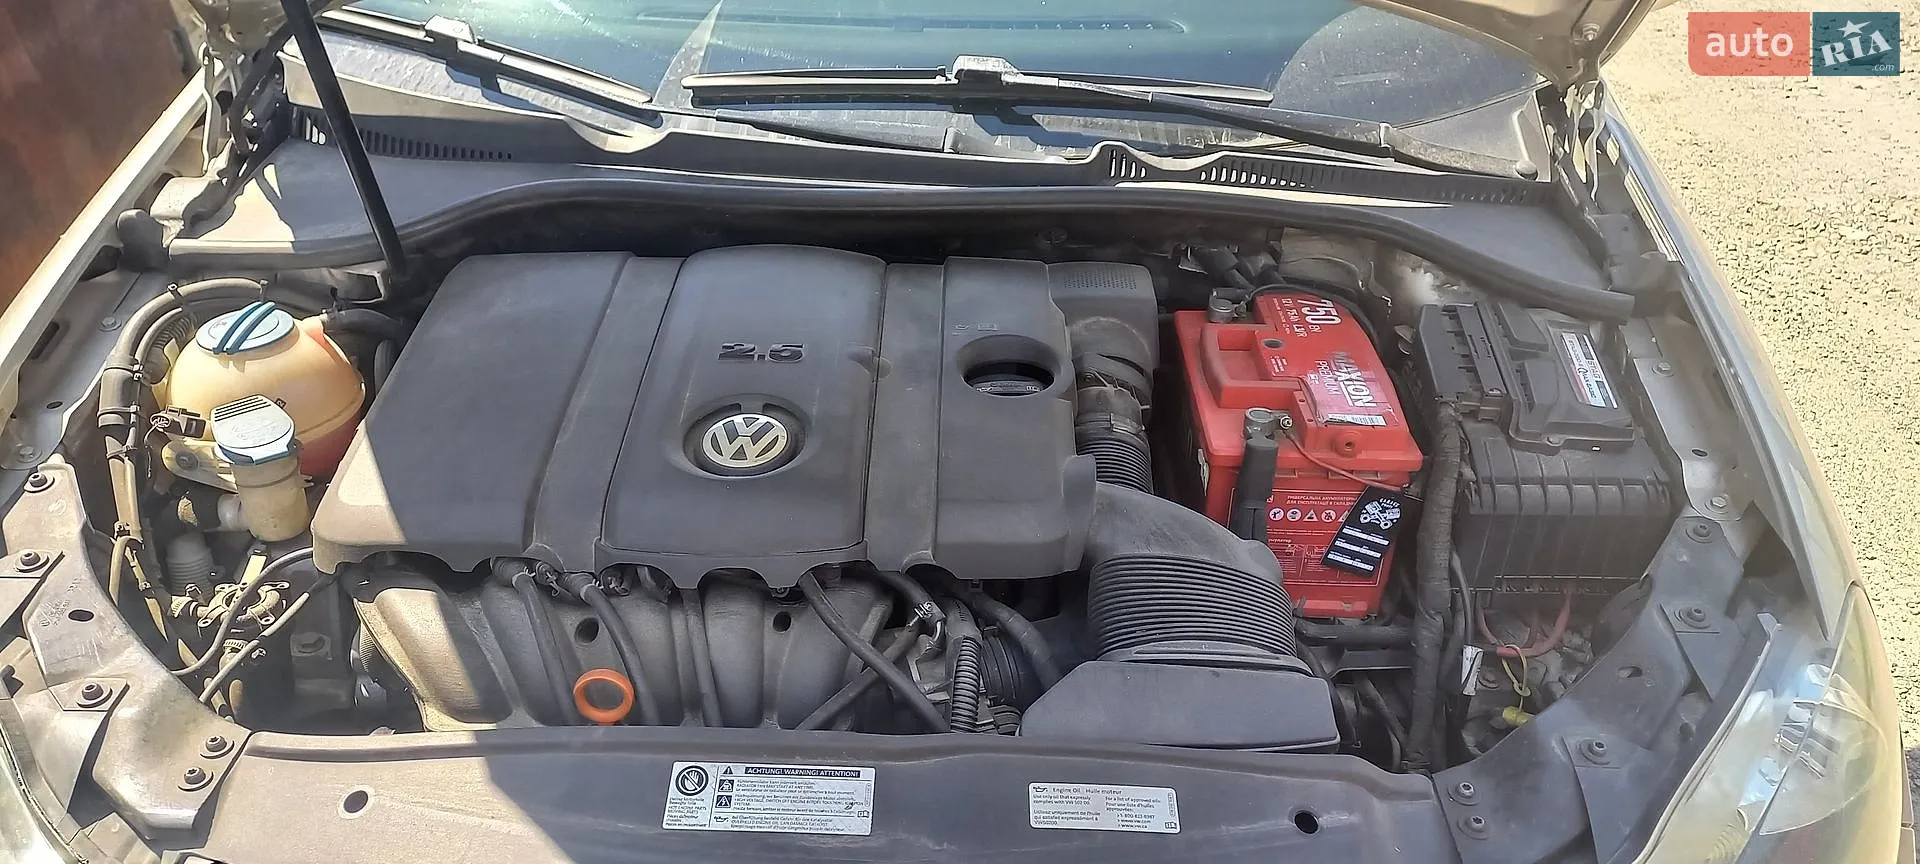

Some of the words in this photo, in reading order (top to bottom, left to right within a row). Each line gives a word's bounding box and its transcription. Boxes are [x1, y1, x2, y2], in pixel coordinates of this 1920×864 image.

[1297, 300, 1342, 325] 750
[718, 343, 804, 363] 2.5
[1314, 360, 1342, 396] PREMIUM
[1334, 351, 1377, 407] MAXION
[702, 413, 788, 468] VW
